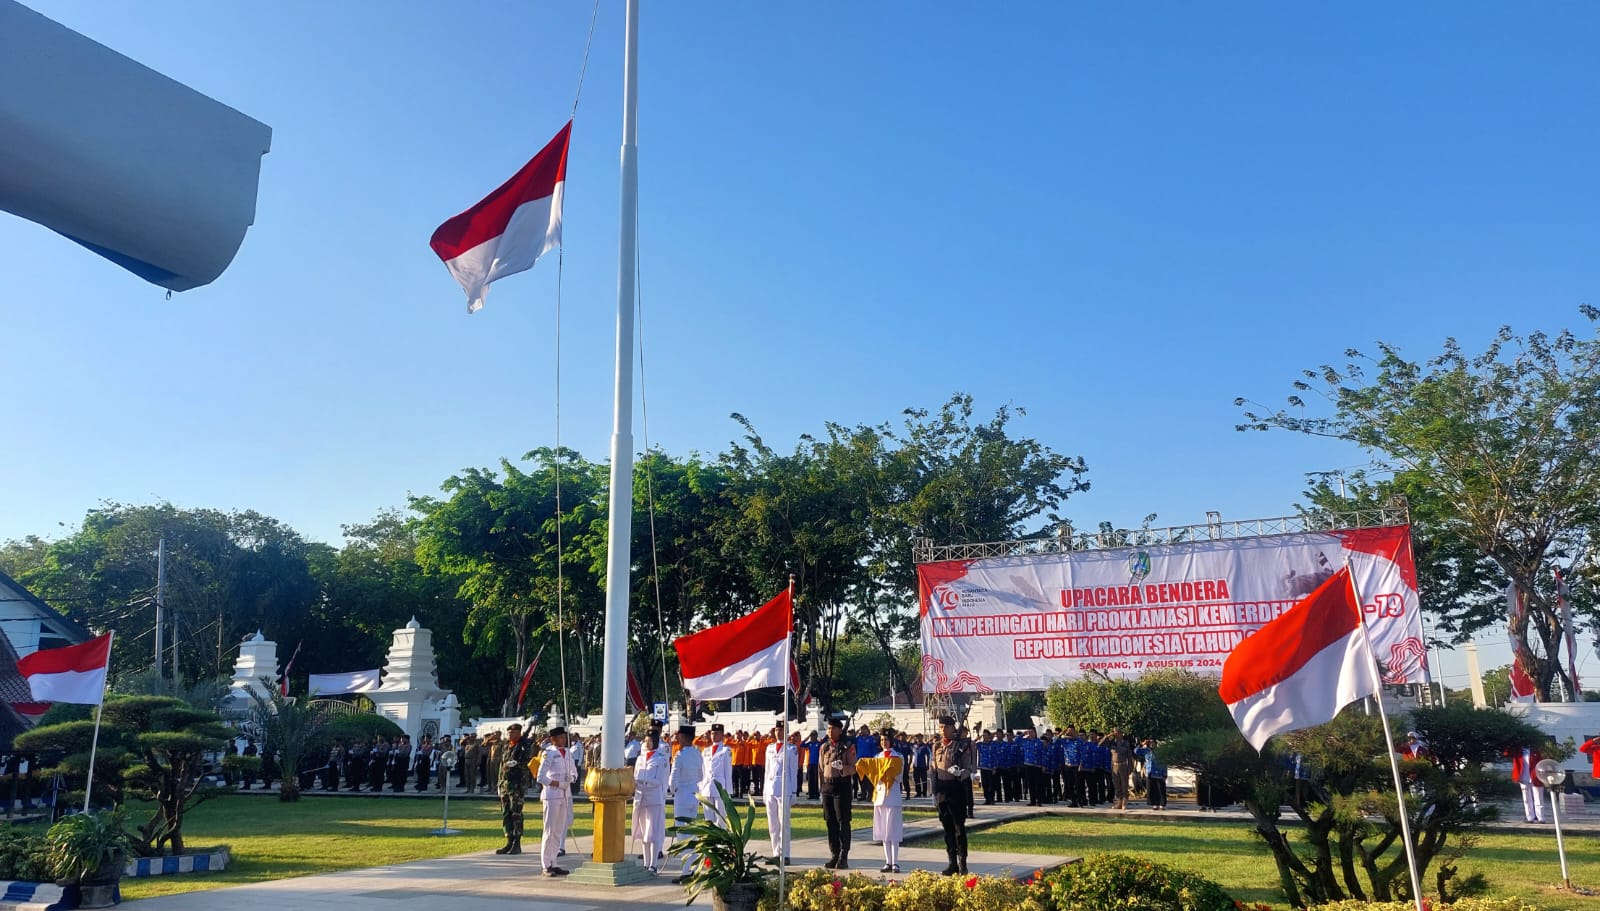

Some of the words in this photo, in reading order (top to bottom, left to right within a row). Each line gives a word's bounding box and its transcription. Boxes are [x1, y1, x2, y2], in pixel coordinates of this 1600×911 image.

[1061, 585, 1142, 608] UPACARA
[1145, 580, 1229, 604] BENDERA
[933, 613, 1044, 637] MEMPERINGATI
[1045, 611, 1085, 633] HARI
[1086, 605, 1196, 632] PROKLAMASI
[1197, 600, 1302, 627] KEMERDEK
[1014, 637, 1091, 659] REPUBLIK
[1091, 633, 1184, 657] INDONESIA
[1183, 630, 1244, 654] TAHUN
[1079, 661, 1131, 670] SAMPANG,
[1133, 661, 1143, 669] 17
[1146, 659, 1194, 668] AGUSTUS
[1197, 659, 1222, 667] 2024
